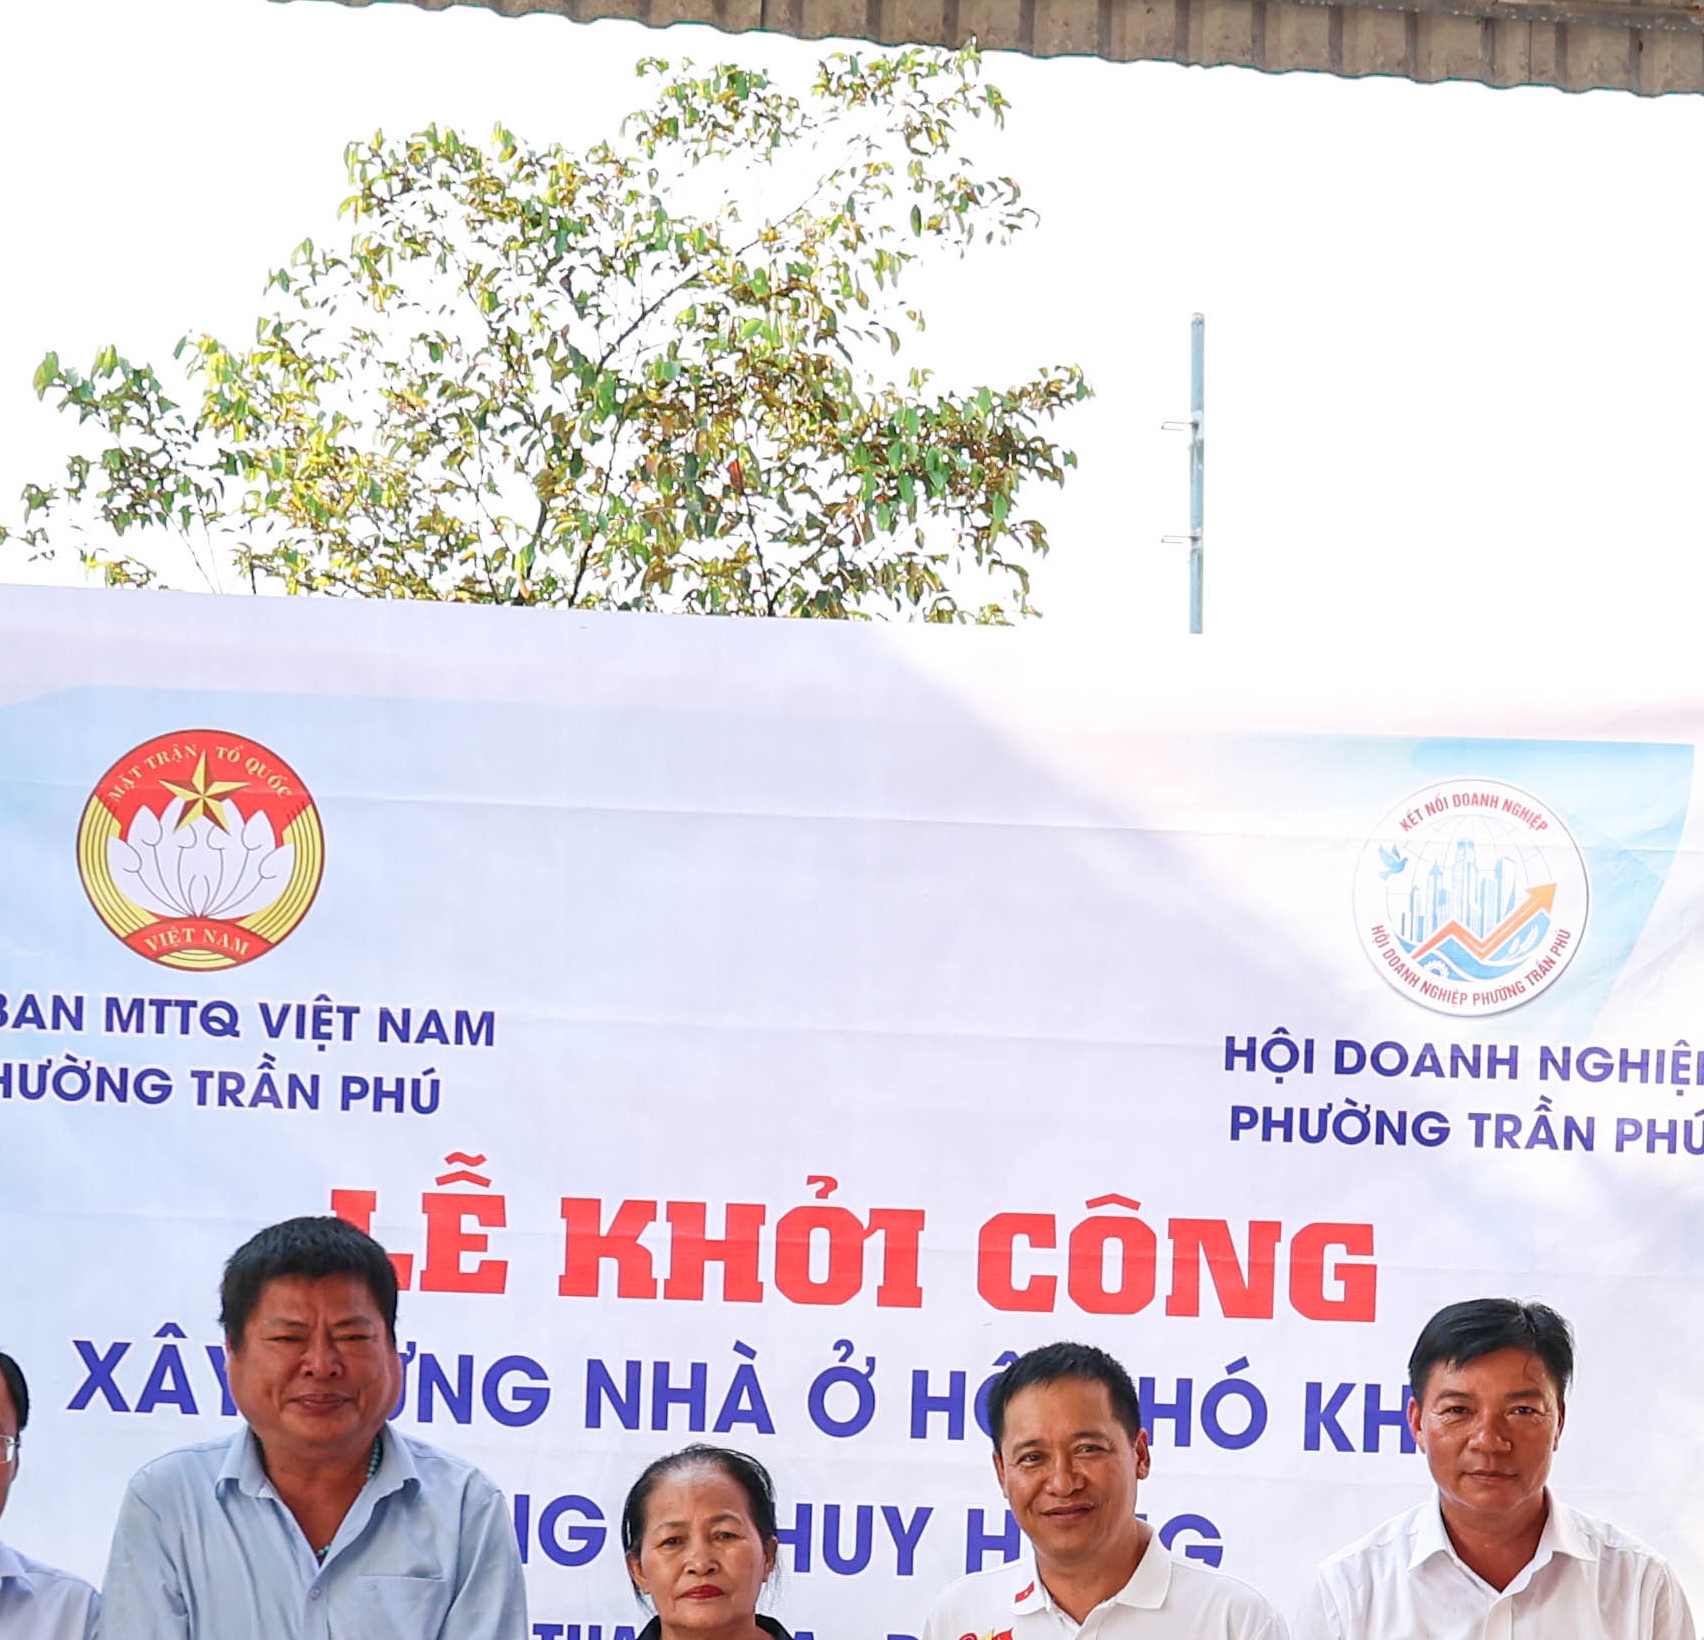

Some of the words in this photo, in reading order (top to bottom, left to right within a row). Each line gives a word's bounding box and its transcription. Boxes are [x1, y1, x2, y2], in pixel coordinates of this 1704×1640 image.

[1452, 792, 1499, 808] DOANH
[201, 928, 250, 957] NAM
[1382, 948, 1421, 994] DOANH
[104, 995, 241, 1039] MTTQ
[258, 993, 361, 1052] VIỆT
[377, 1006, 495, 1048] NAM
[189, 1051, 321, 1111] TRẦN
[339, 1066, 442, 1116] PHÚ
[1224, 1026, 1315, 1085] HỘI
[1333, 1038, 1519, 1081] DOANH
[1230, 1096, 1452, 1149] PHƯỜNG
[1467, 1095, 1596, 1153] TRẦN
[558, 1175, 926, 1309] KHỞI
[977, 1192, 1378, 1323] CÔNG
[387, 1341, 551, 1428] NG
[584, 1339, 776, 1435] NHÀ
[808, 1339, 877, 1438] Ở
